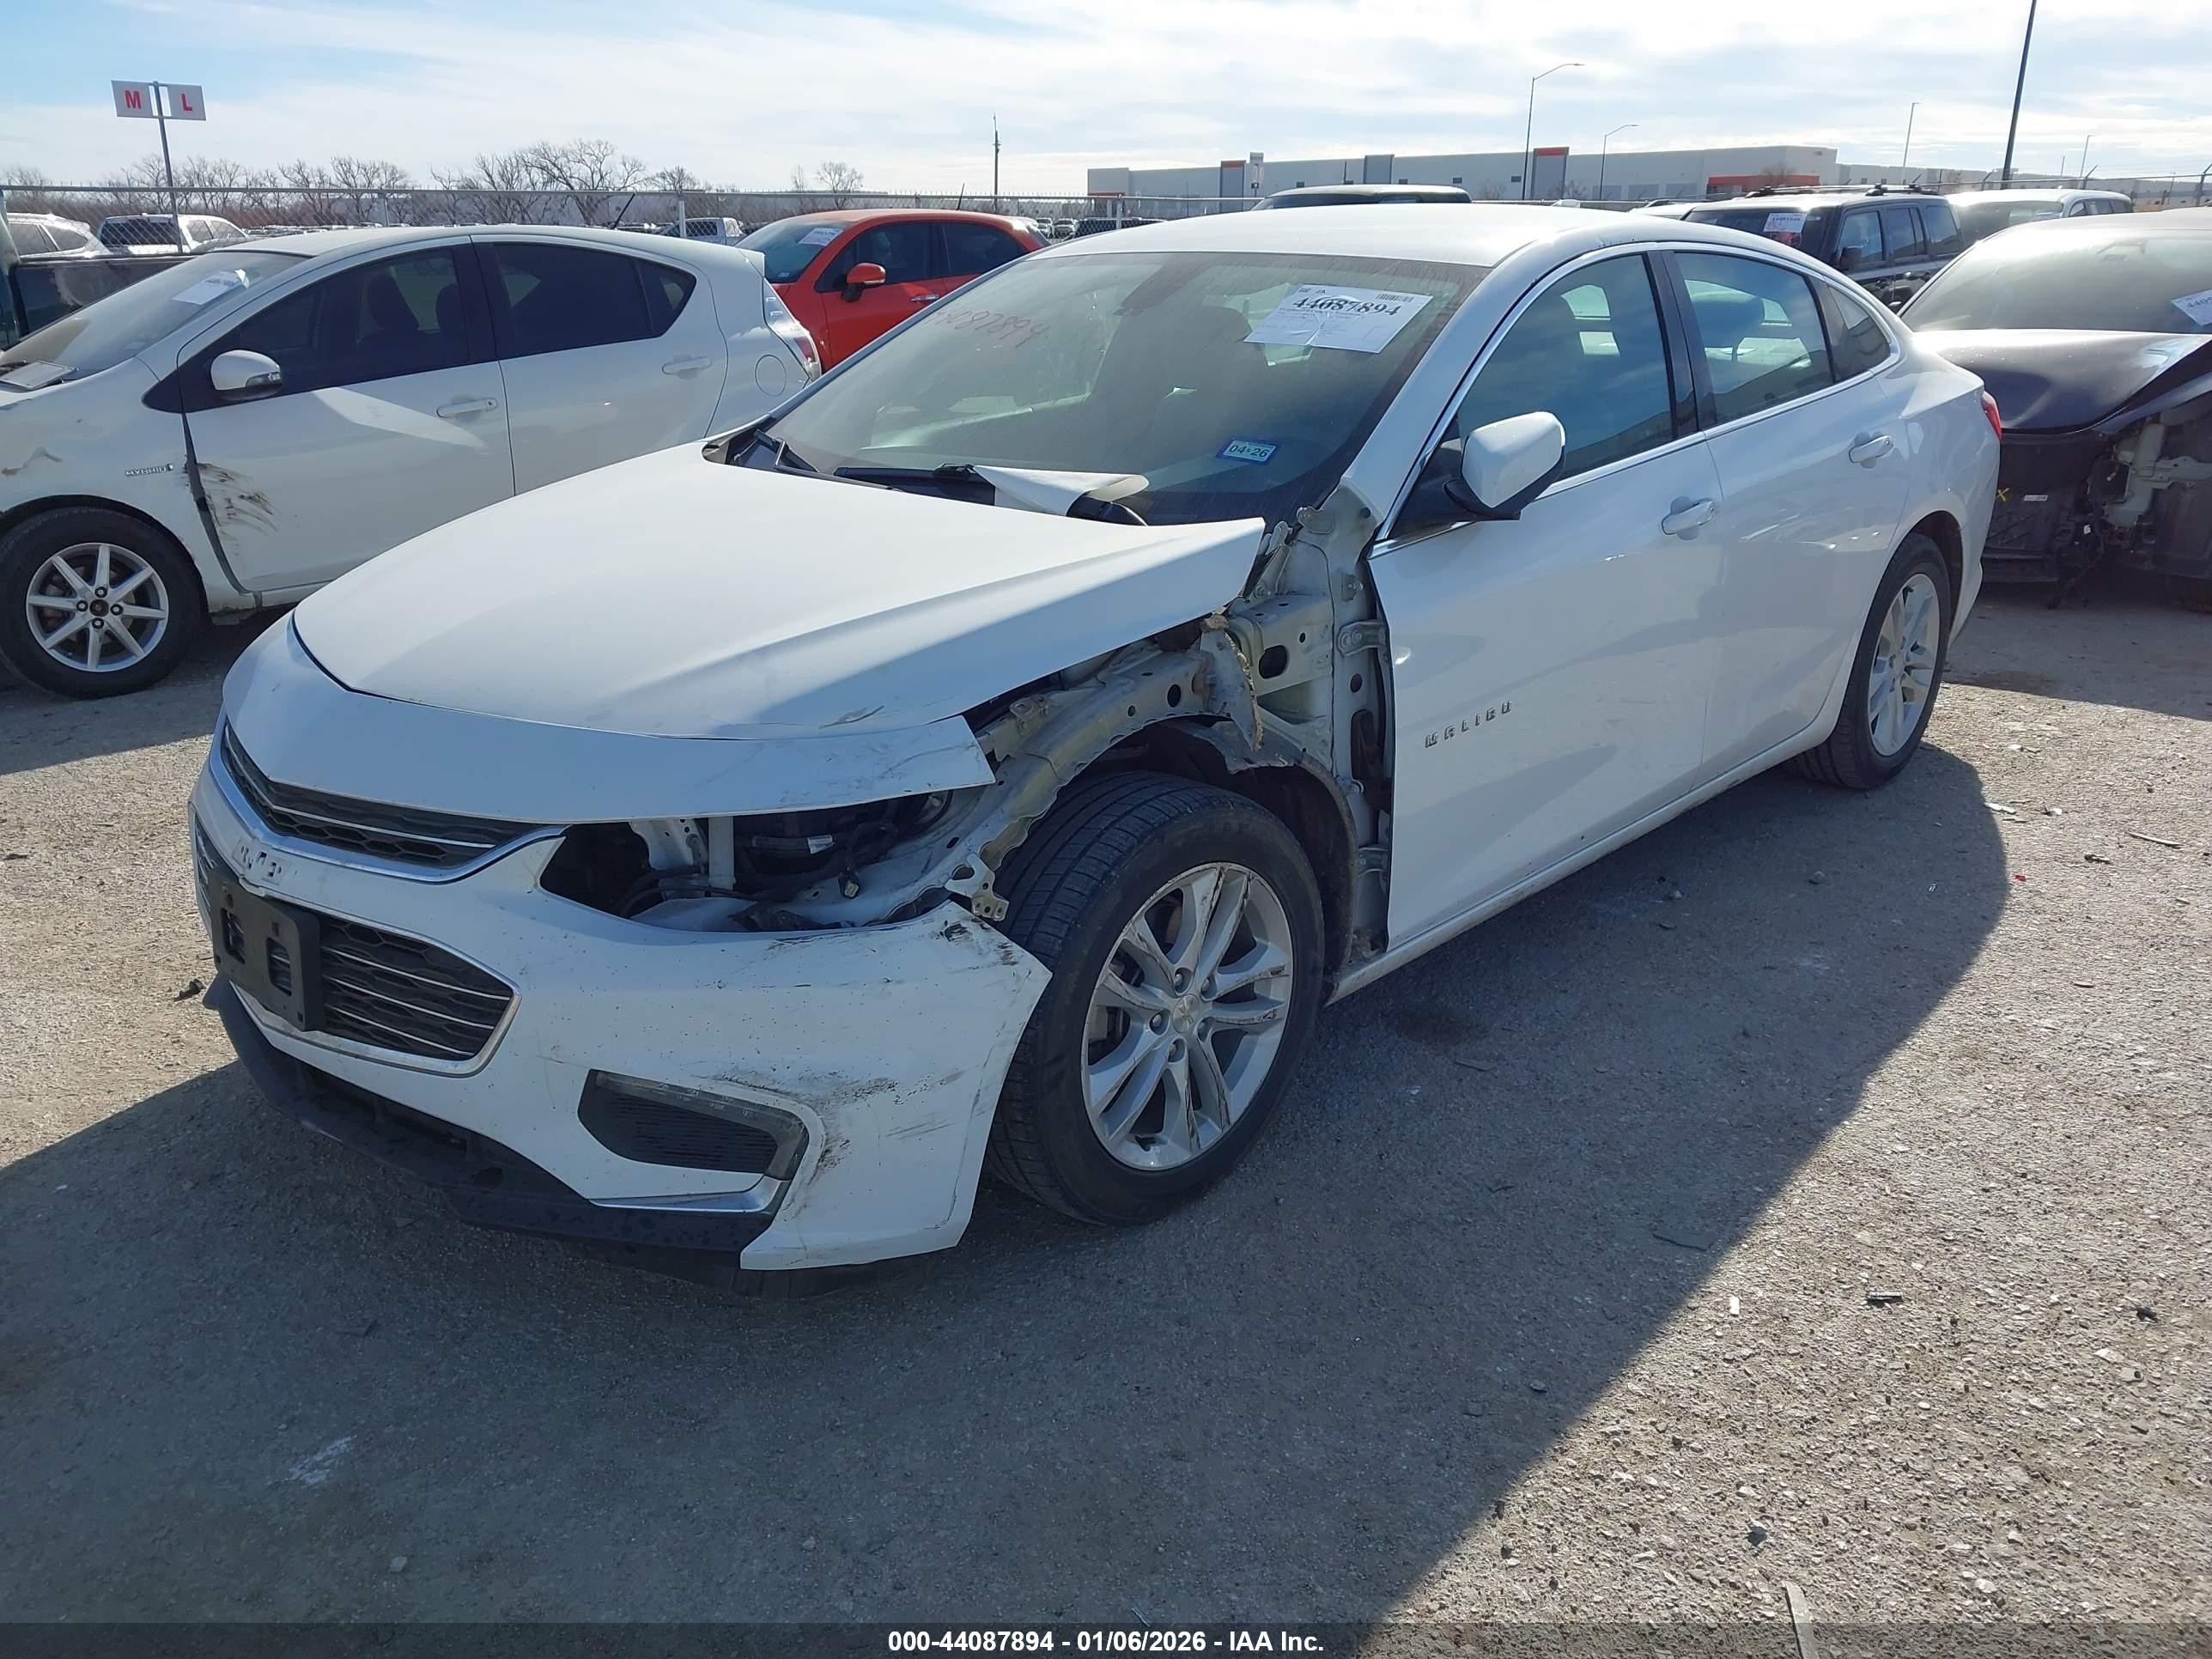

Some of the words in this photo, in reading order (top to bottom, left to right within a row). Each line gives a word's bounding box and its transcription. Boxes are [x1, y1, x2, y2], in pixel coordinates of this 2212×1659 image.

[125, 90, 142, 109] M
[181, 93, 193, 112] L
[1291, 296, 1402, 316] 44087894
[125, 466, 167, 477] HYBRID
[1425, 701, 1512, 749] MALIBU
